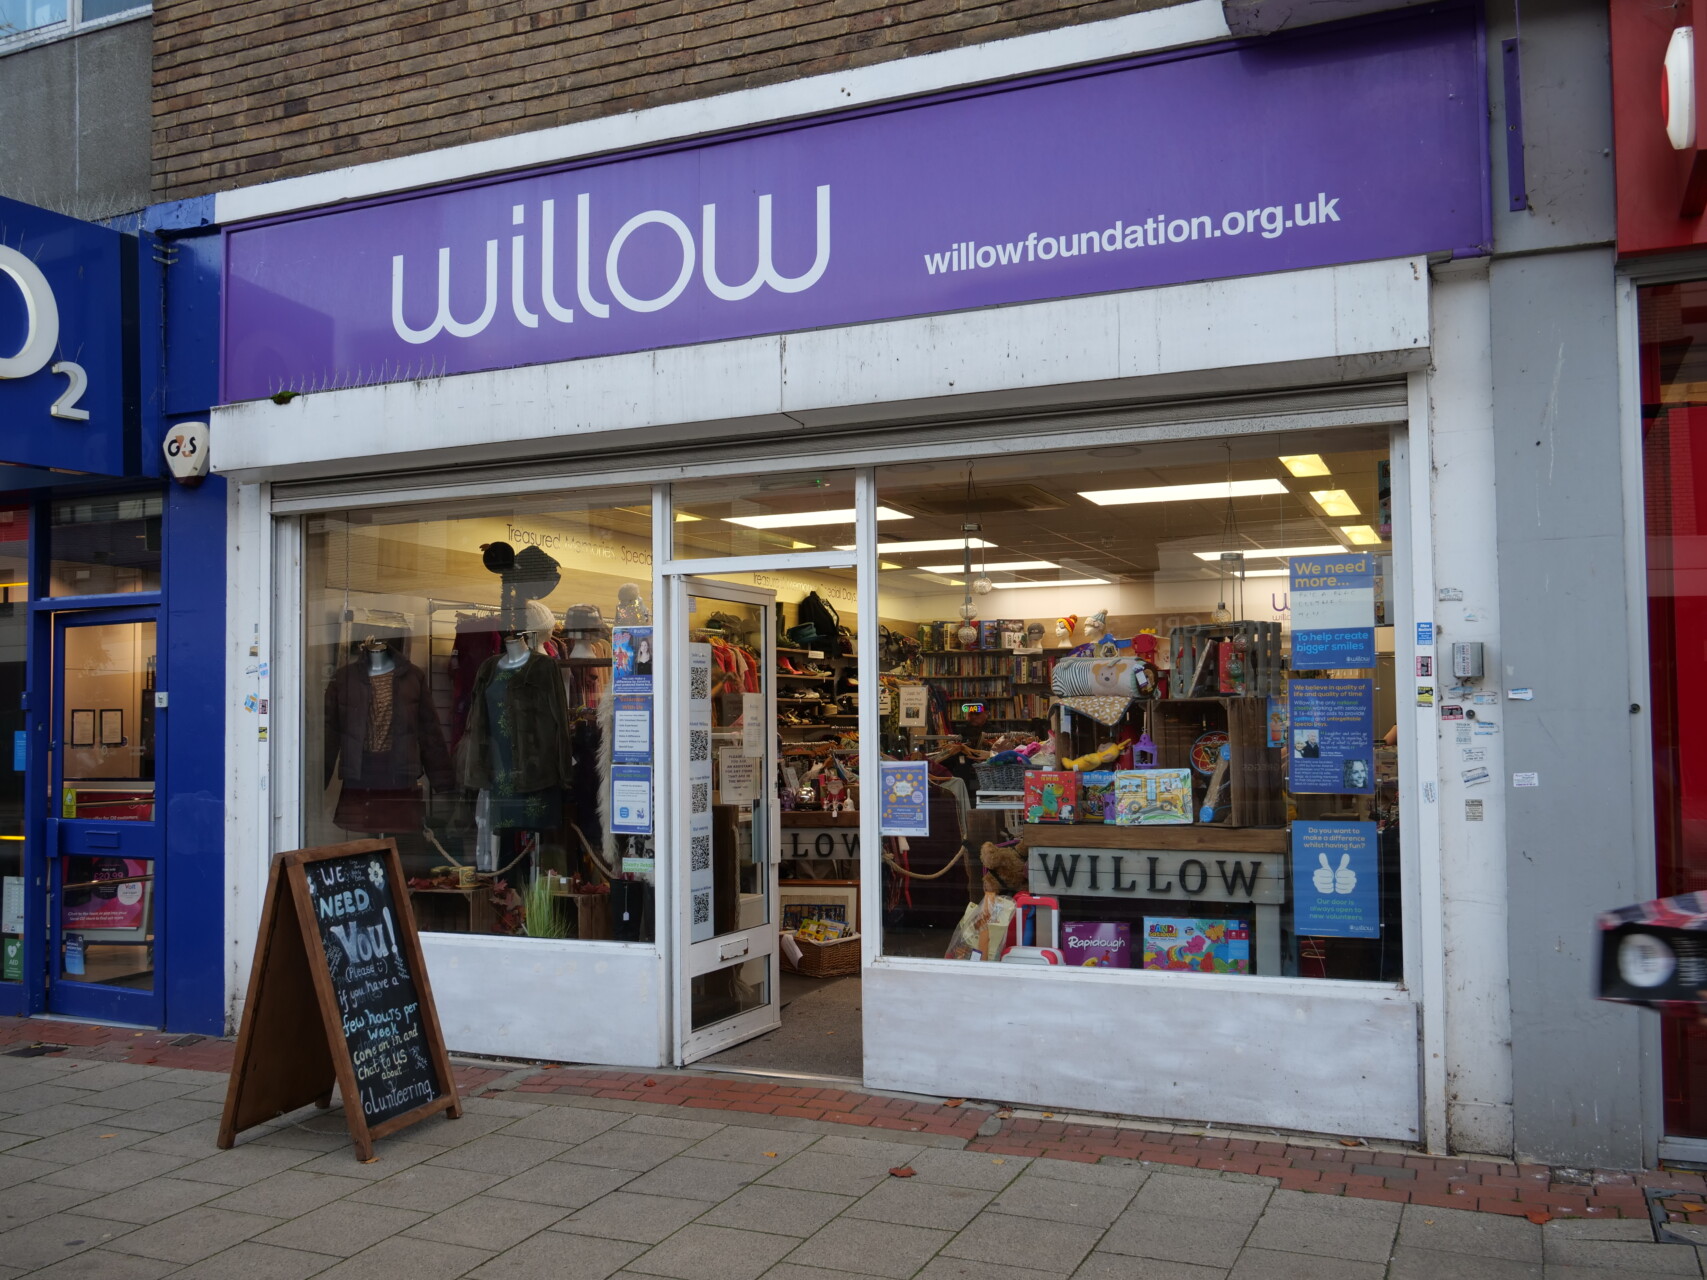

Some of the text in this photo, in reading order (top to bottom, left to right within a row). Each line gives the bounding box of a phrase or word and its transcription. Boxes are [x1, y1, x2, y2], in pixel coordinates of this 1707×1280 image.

[923, 191, 1340, 277] willowfoundation.org.uk
[390, 184, 831, 345] willow
[506, 523, 561, 548] Treasured
[1295, 560, 1366, 575] We need
[1295, 576, 1350, 588] more...
[1296, 632, 1369, 643] To help create
[1296, 641, 1364, 655] bigger smiles
[781, 832, 860, 858] LOW
[1325, 842, 1348, 850] having
[320, 866, 345, 886] WE
[1038, 853, 1262, 897] WILLOW
[320, 888, 370, 919] NEED
[330, 906, 398, 963] You!
[1149, 924, 1175, 933] SAND
[1068, 935, 1126, 952] Rapidough
[338, 976, 399, 1013] if you have a
[342, 1002, 418, 1037] few hours per
[378, 1040, 390, 1052] on
[403, 1022, 419, 1042] and
[380, 1055, 391, 1069] to
